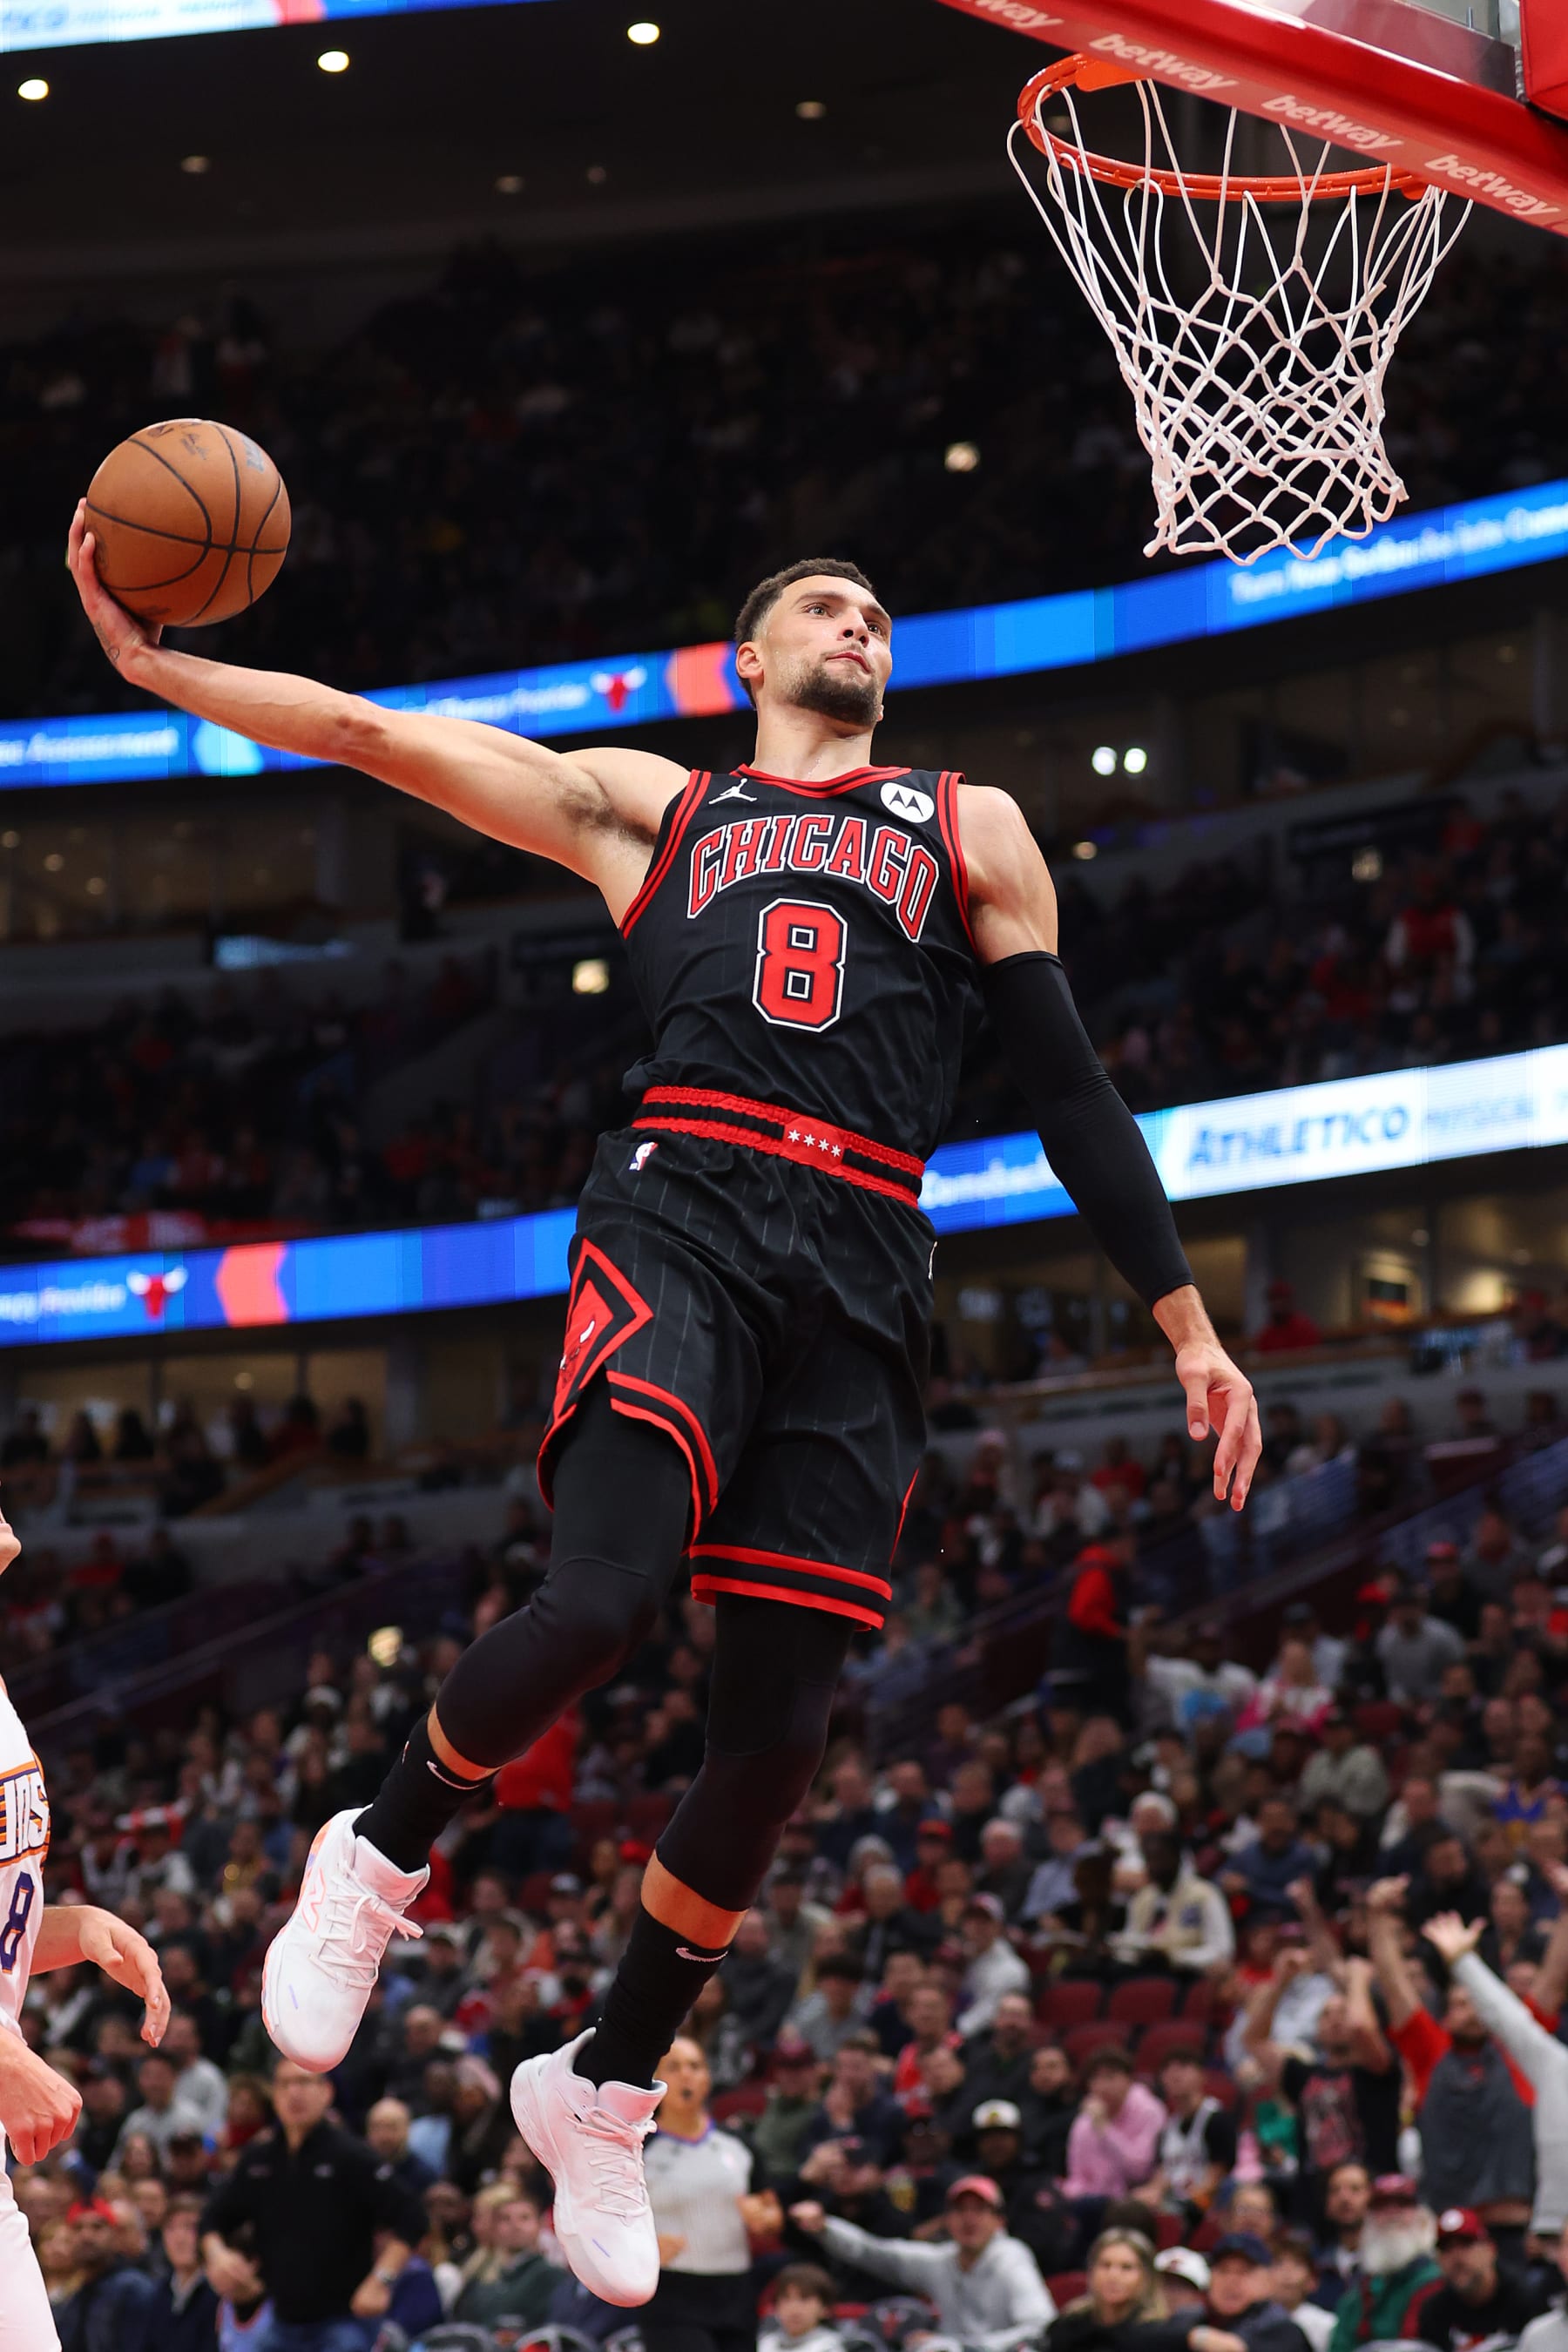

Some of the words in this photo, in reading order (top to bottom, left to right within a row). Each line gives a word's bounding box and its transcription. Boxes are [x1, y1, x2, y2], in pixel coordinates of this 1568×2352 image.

[1089, 33, 1240, 90] betway
[1261, 95, 1404, 149] betway
[1423, 154, 1561, 215] betway
[687, 814, 939, 943] CHICAGO
[753, 898, 848, 1032] 8
[0, 1870, 35, 1974] 8
